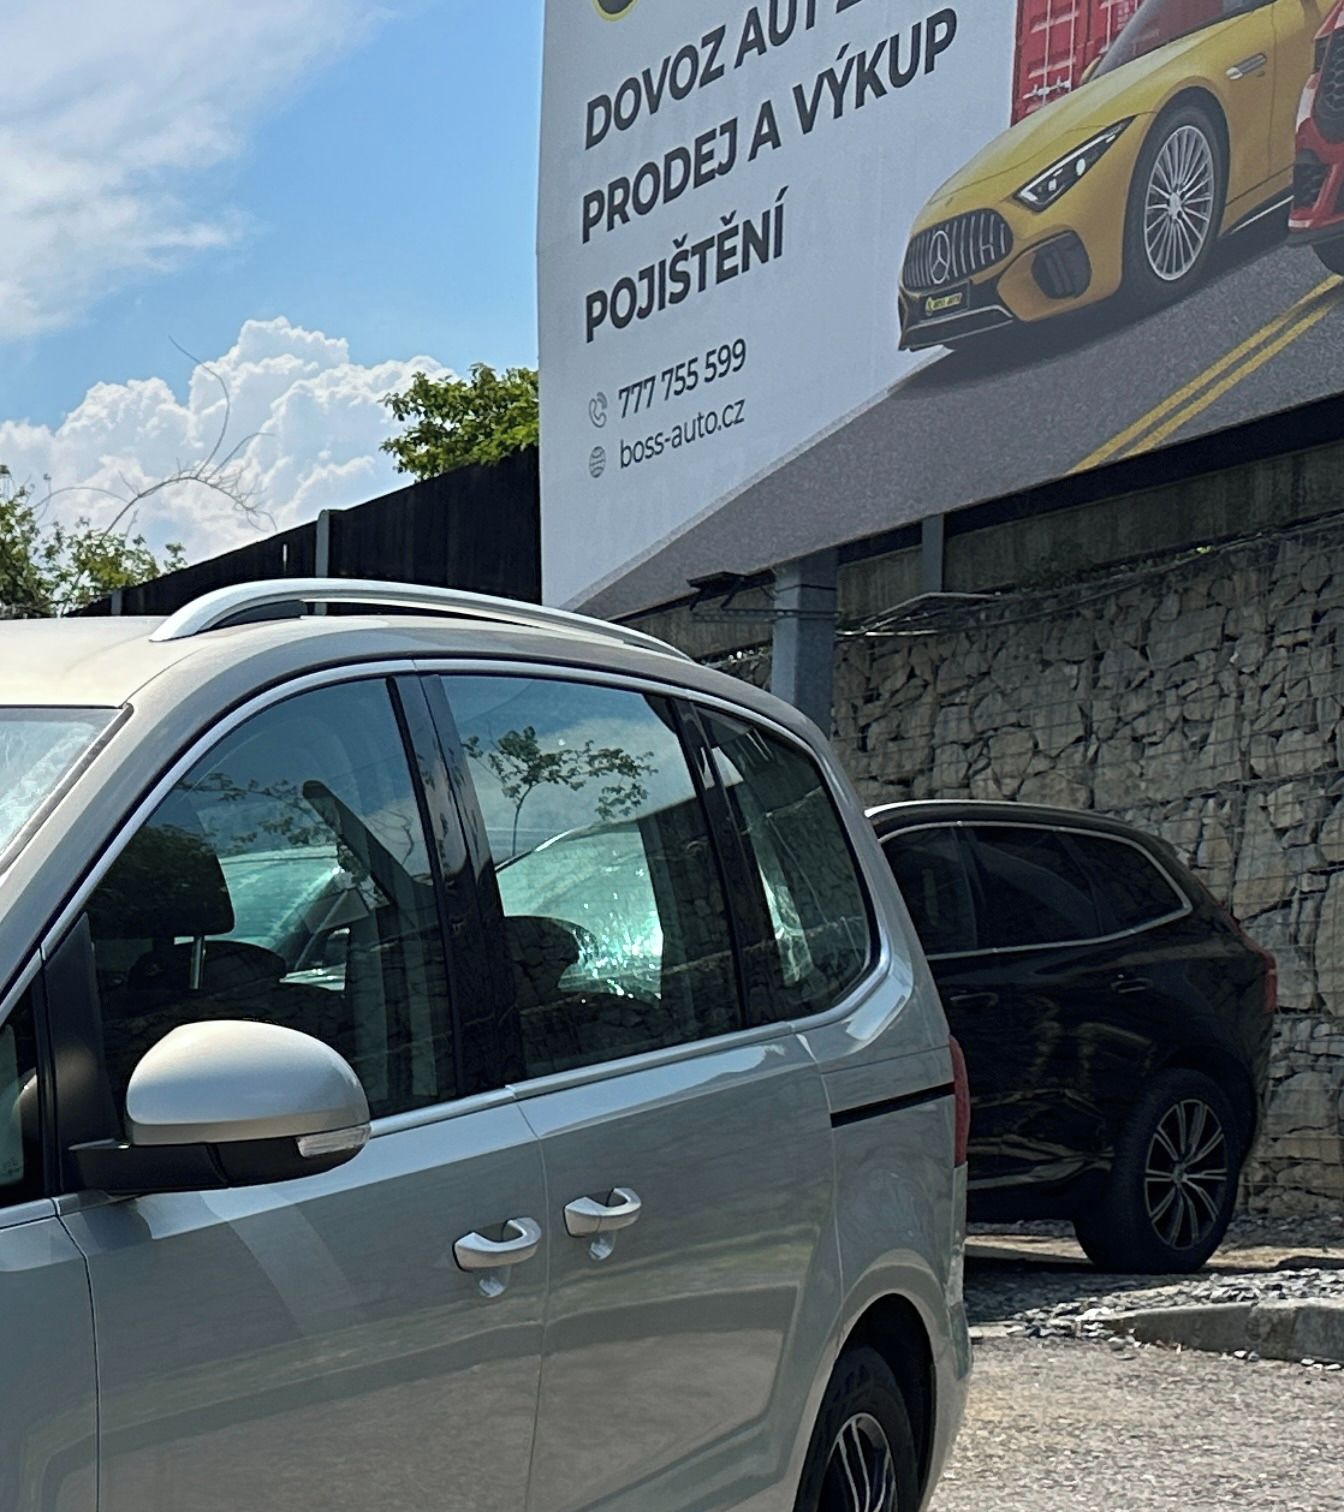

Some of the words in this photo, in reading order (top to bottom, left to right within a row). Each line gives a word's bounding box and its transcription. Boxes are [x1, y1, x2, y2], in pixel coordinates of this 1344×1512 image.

[582, 117, 738, 244] PRODEJ
[747, 100, 782, 162] A
[792, 8, 958, 135] VÝKUP
[585, 24, 726, 150] DOVOZ
[586, 185, 789, 343] POJIŠTĚNÍ
[618, 375, 656, 419] 777
[661, 357, 698, 401] 755
[704, 338, 746, 383] 599
[620, 398, 745, 469] boss-auto.cz
